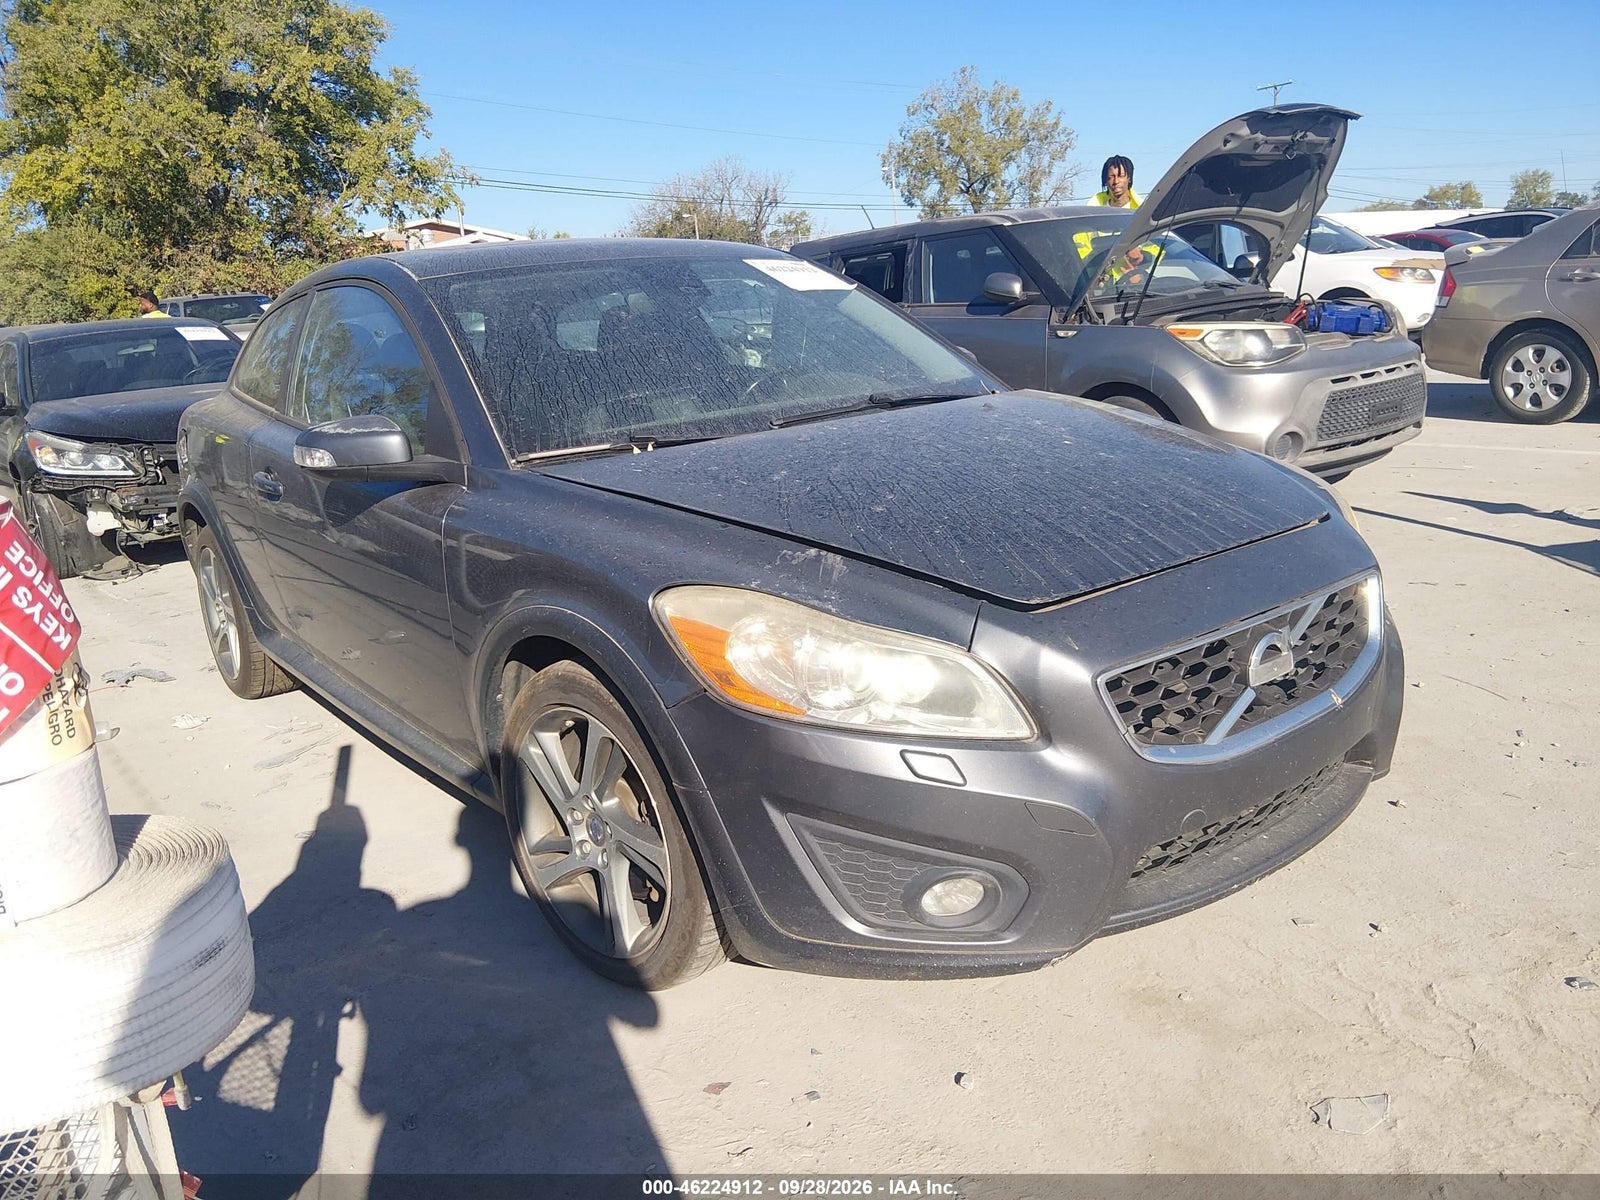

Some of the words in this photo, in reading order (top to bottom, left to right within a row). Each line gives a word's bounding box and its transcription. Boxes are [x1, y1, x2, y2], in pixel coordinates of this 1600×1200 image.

[4, 540, 75, 623] OFFICE
[12, 585, 72, 650] KEYS
[54, 668, 76, 739] OHAZARD
